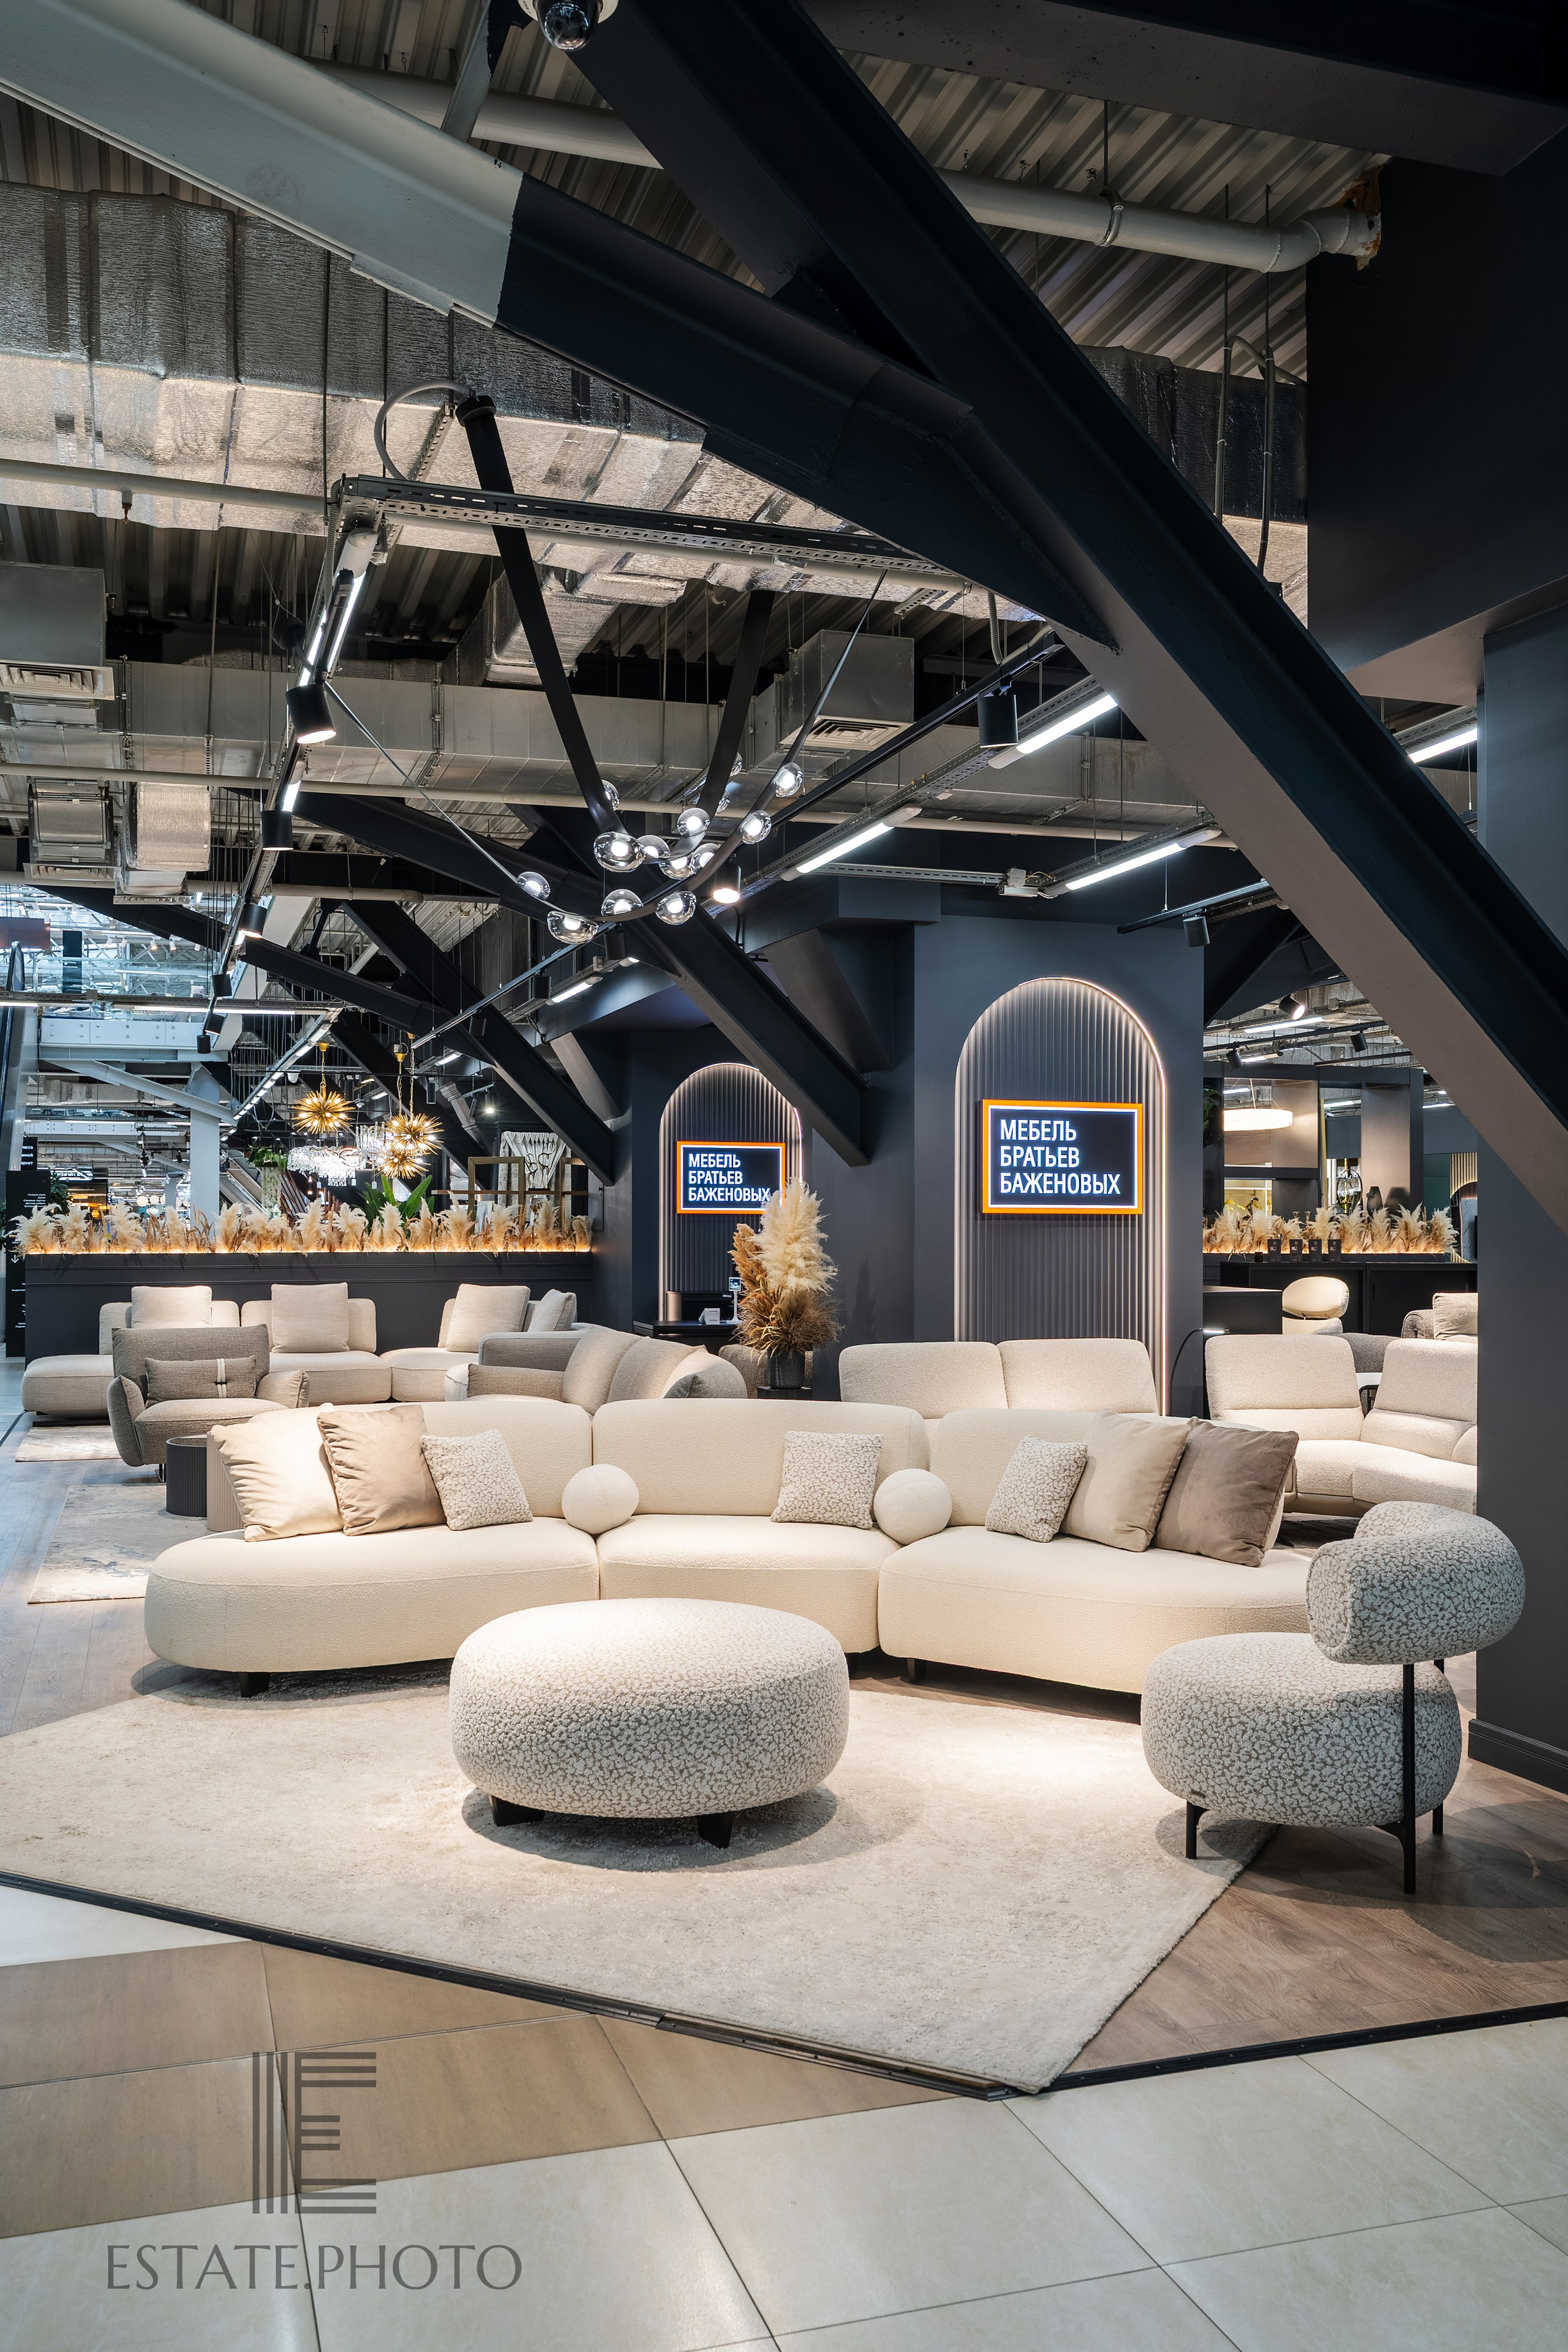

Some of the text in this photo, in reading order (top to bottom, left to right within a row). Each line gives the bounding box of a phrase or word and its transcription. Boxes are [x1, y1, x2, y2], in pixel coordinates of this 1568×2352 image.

[1000, 1119, 1077, 1141] МЕБЕЛЬ
[688, 1153, 741, 1168] МЕБЕЛЬ
[1000, 1146, 1080, 1167] БРАТЬЕВ
[688, 1170, 743, 1185] БРАТЬЕВ
[1000, 1172, 1121, 1194] БАЖЕНОВЫХ
[688, 1187, 771, 1202] БАЖЕНОВЫХ
